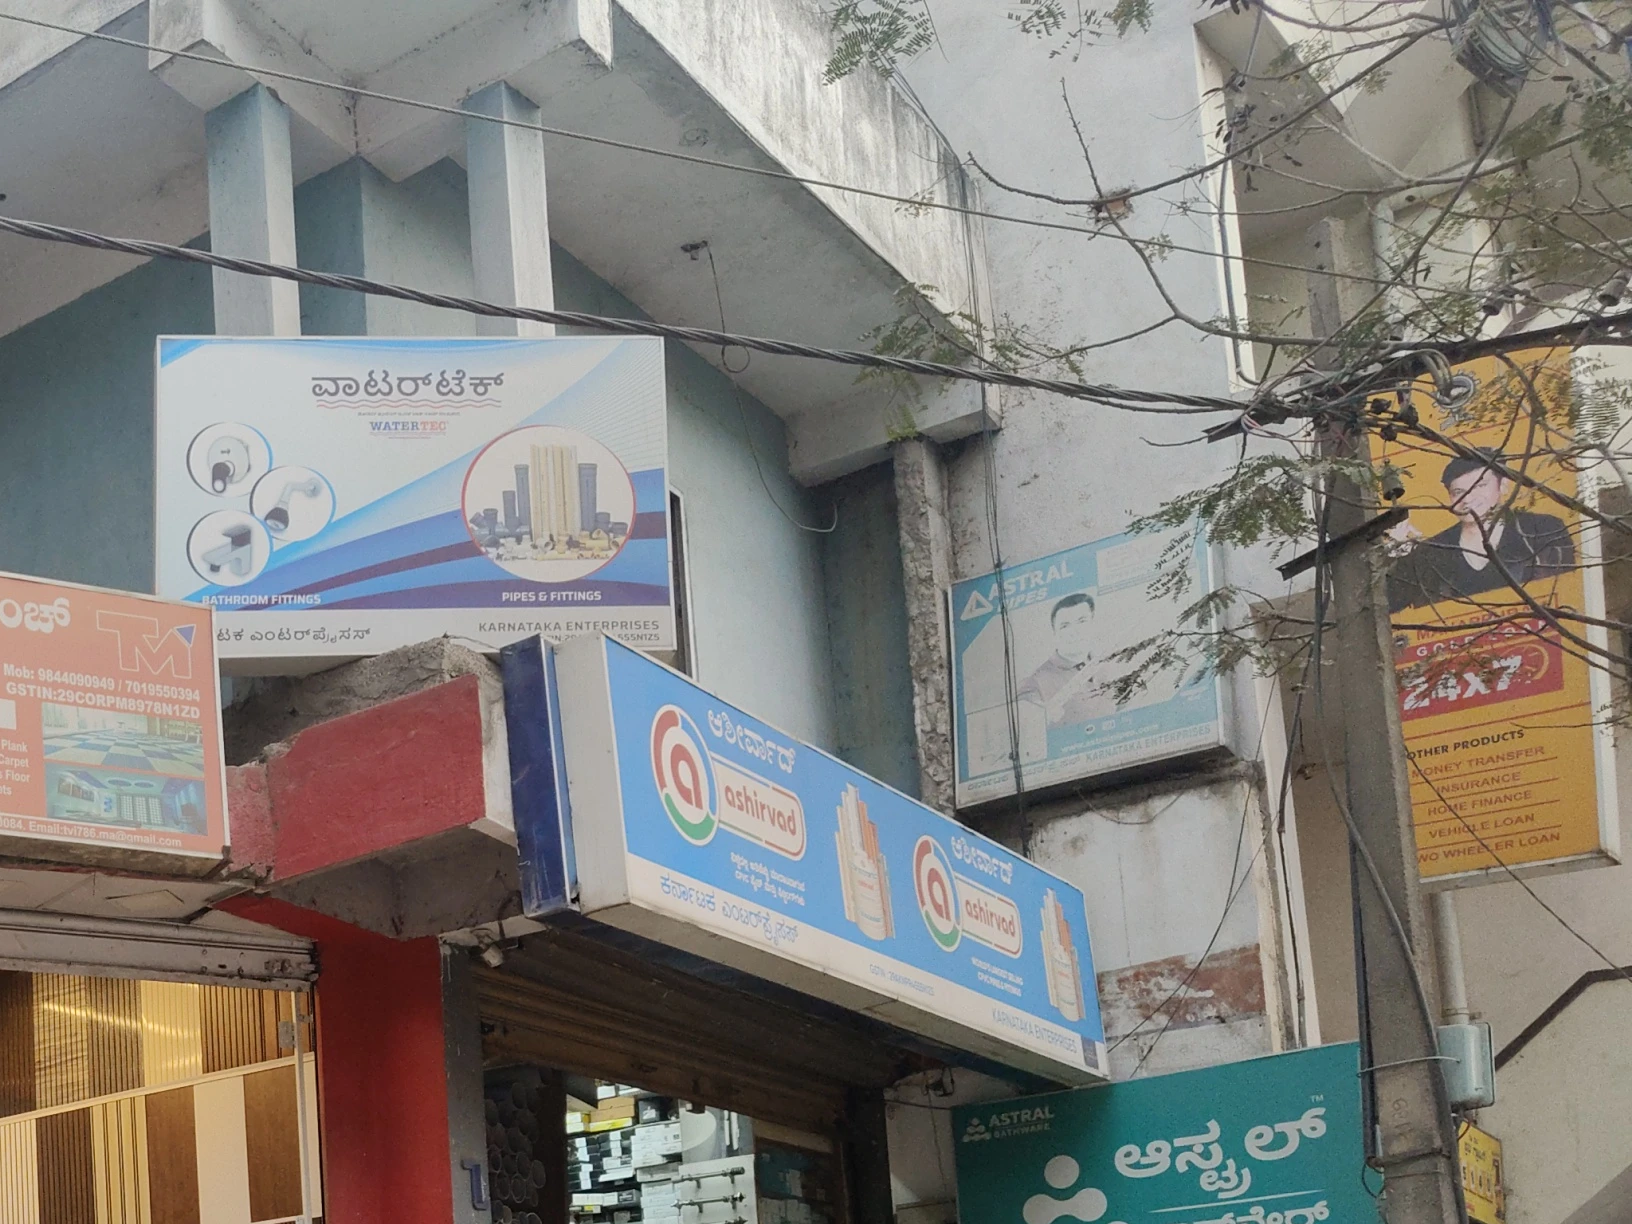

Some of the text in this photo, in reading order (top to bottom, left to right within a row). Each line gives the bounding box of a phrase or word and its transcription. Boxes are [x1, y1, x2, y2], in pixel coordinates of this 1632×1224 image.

[369, 420, 447, 432] WATERTEC
[988, 560, 1073, 600] ASTRAL
[202, 593, 321, 606] BATHROOM FITTINGS
[502, 590, 601, 602] PIPES & FITTINGS
[478, 619, 659, 633] KARNATAKA ENTERPRISES
[3, 662, 34, 679] Mob:
[38, 667, 115, 691] 9844090949
[125, 680, 200, 703] 7019550394
[1406, 729, 1525, 760] OTHER PRODUCTS
[1411, 746, 1545, 778] MONEY TRANSFER
[1437, 771, 1521, 794] INSURANCE
[725, 785, 797, 836] ashirvad
[1428, 789, 1532, 816] HOME FINANCE
[1429, 813, 1535, 838] VEHICLE LOAN
[1443, 832, 1560, 859] WHEELER LOAN
[965, 899, 1016, 938] ashirvad
[991, 1008, 1077, 1053] KARNATAKA ENTERPRISES
[989, 1105, 1054, 1128] ASTRAL
[993, 1122, 1050, 1138] BATHWARE
